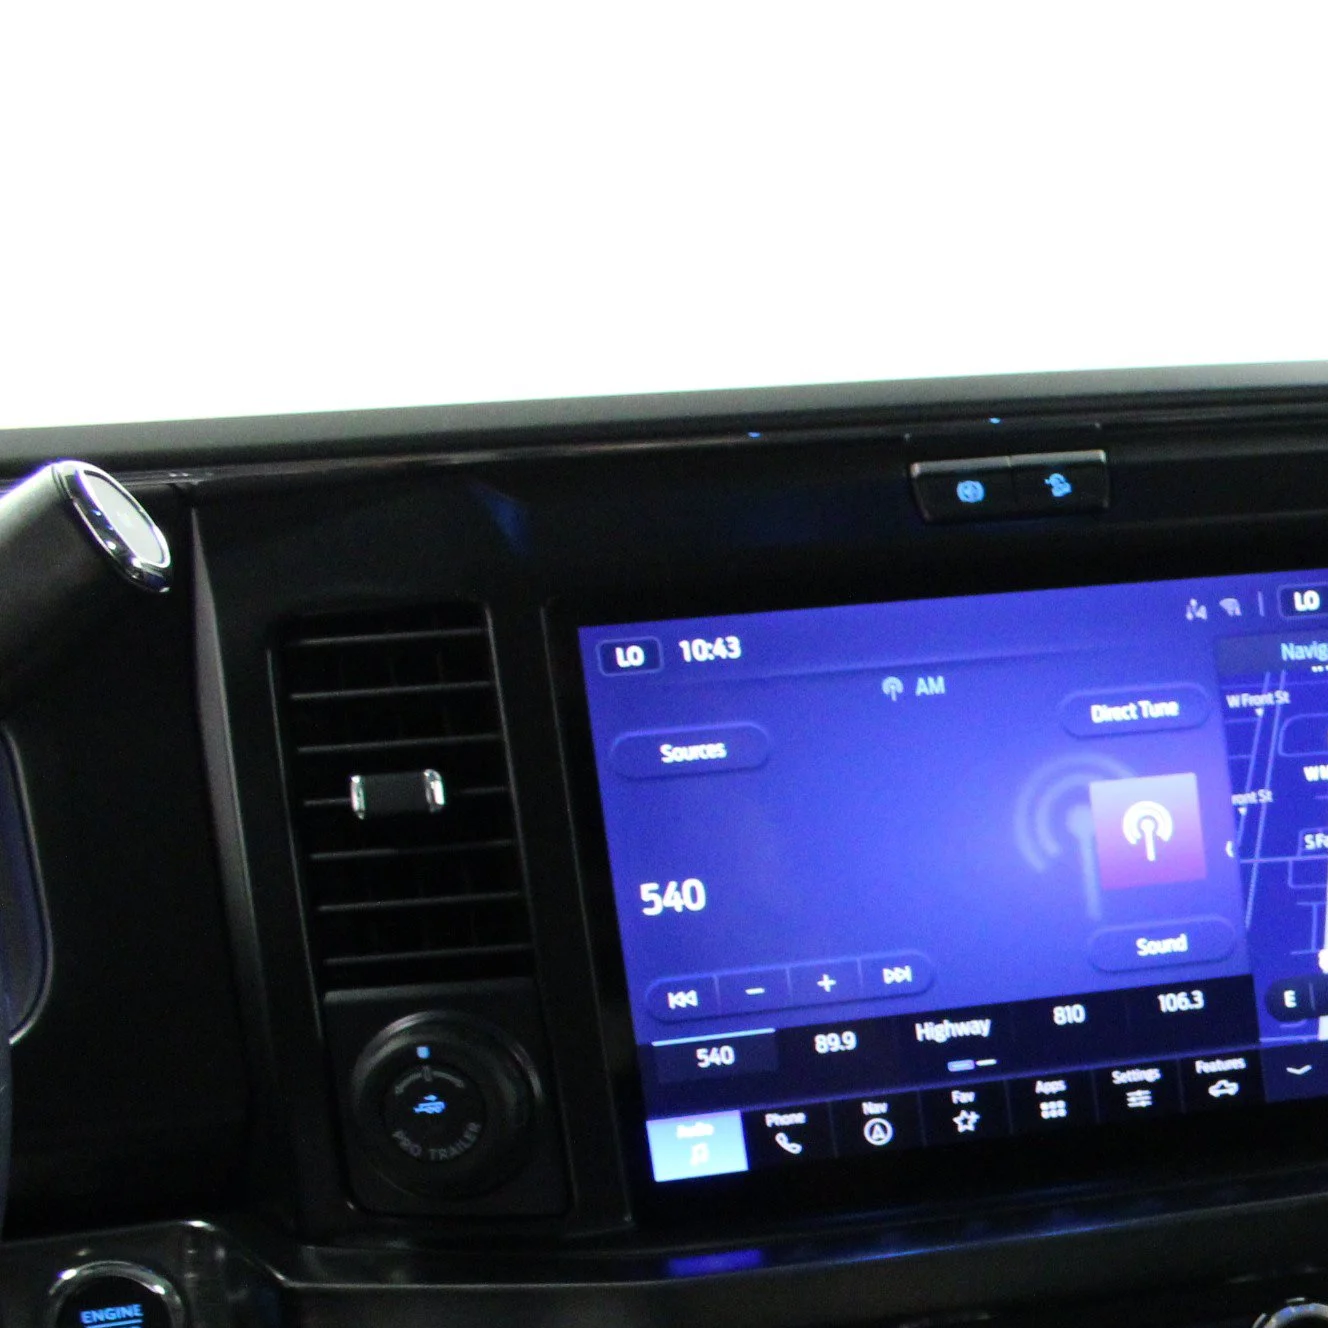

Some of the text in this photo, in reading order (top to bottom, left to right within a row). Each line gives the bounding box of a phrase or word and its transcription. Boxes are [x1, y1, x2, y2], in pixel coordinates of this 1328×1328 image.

[1294, 591, 1320, 611] LO
[616, 646, 645, 667] LO
[679, 636, 742, 662] 10:43
[915, 676, 945, 696] AM
[1226, 690, 1290, 709] W Front St
[1091, 700, 1179, 724] Direct Tune
[660, 742, 727, 763] Sources
[1258, 789, 1273, 803] St
[640, 878, 707, 916] 540
[1136, 934, 1188, 956] Sound
[1158, 990, 1205, 1013] 106.3
[1284, 990, 1297, 1008] E
[1053, 1003, 1086, 1026] 810
[915, 1017, 991, 1043] Highway
[814, 1031, 857, 1053] 89.9
[696, 1045, 735, 1068] 540
[1195, 1055, 1246, 1075] Features
[1112, 1066, 1161, 1086] Settings
[951, 1090, 975, 1105] Fav
[1035, 1079, 1067, 1097] Apps
[765, 1110, 806, 1128] Phone
[863, 1101, 888, 1116] Nav
[81, 1303, 143, 1325] ENGINE
